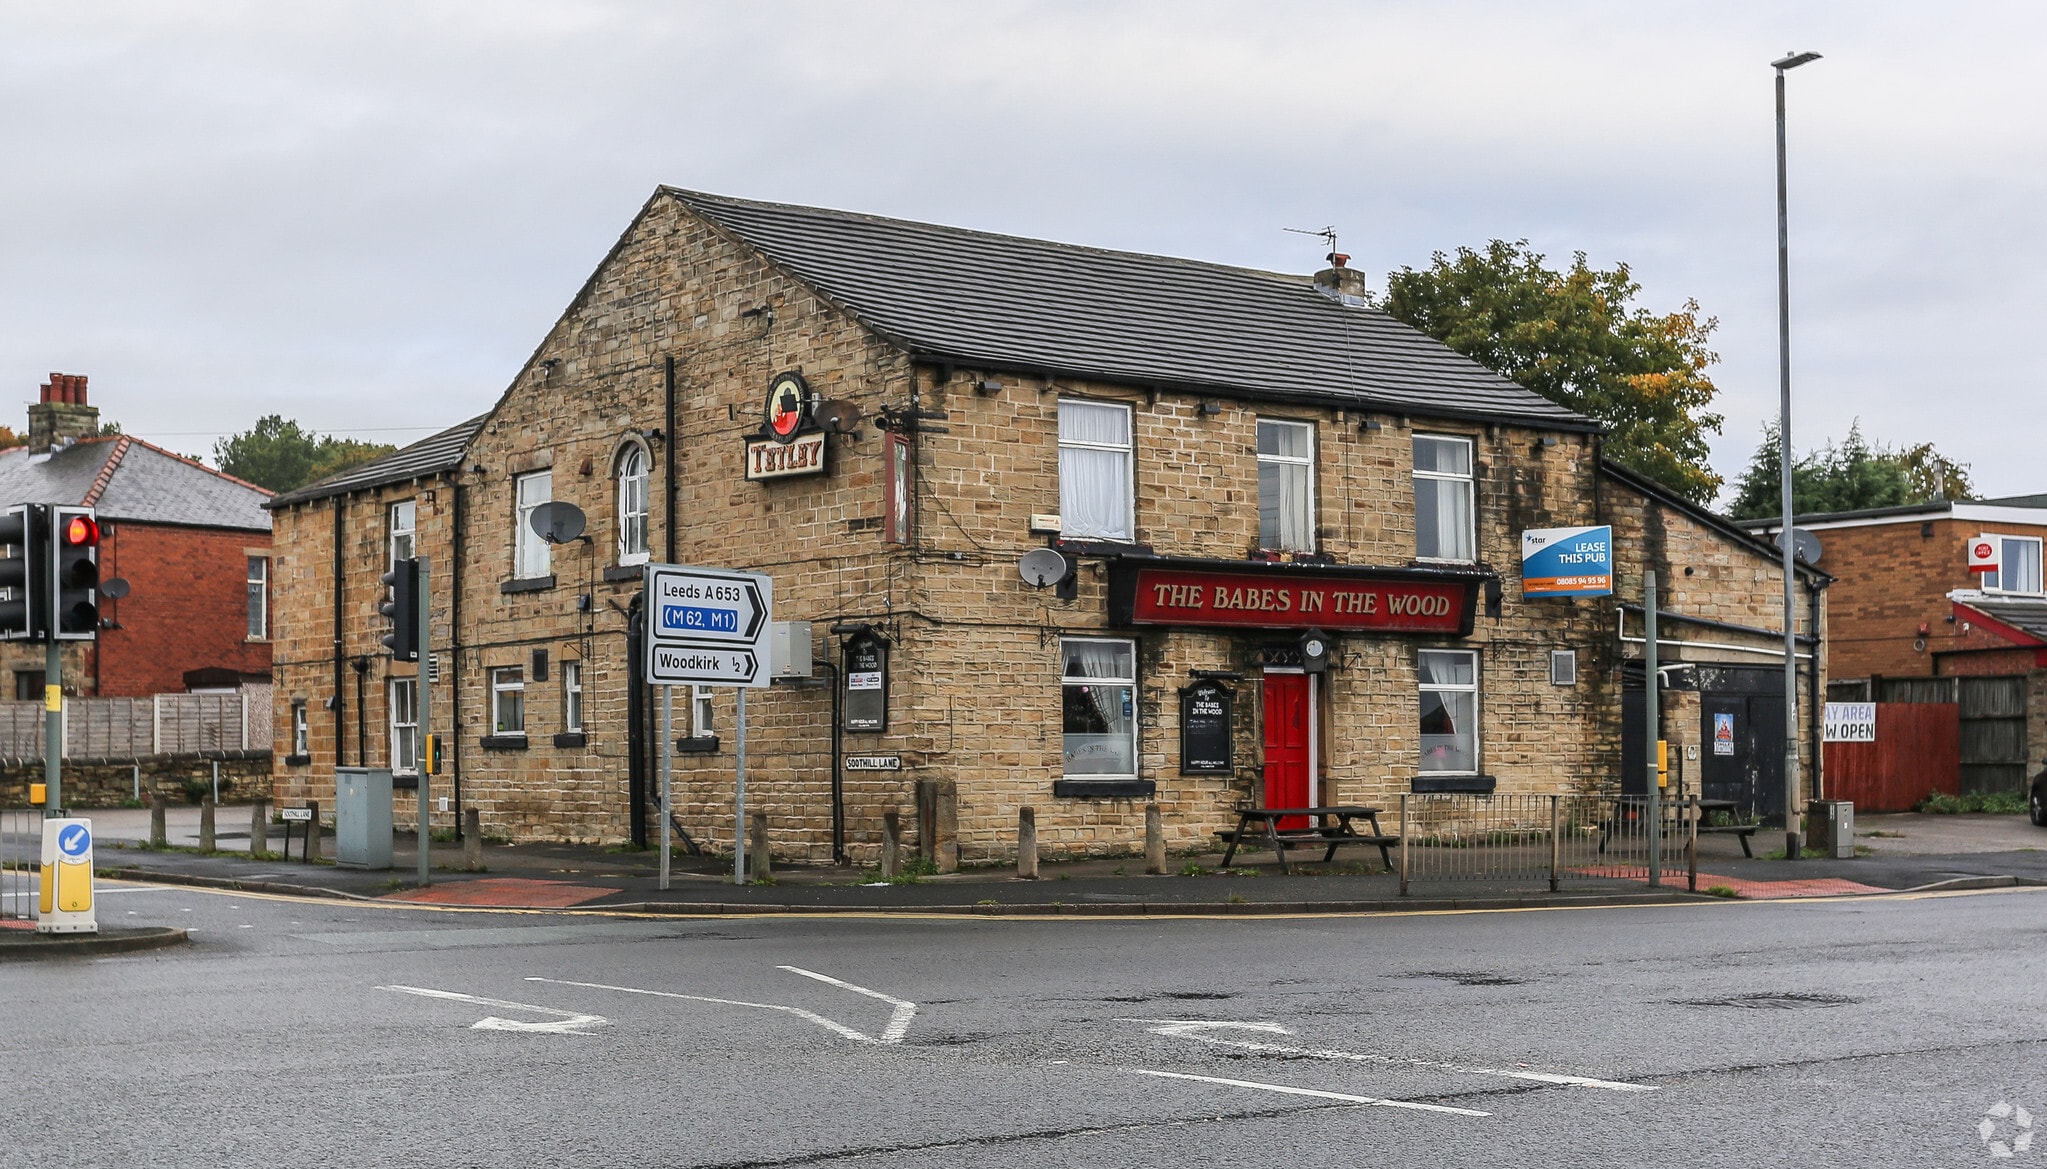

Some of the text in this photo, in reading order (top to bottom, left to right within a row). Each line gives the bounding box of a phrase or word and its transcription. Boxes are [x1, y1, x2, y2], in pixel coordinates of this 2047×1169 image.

[751, 441, 822, 473] TETLEY
[1531, 536, 1546, 545] star
[1575, 542, 1606, 553] LEASE
[1558, 552, 1606, 564] THIS PUB
[1556, 577, 1577, 586] 08085
[1577, 577, 1586, 585] 94
[1588, 576, 1597, 585] 95
[1597, 576, 1606, 584] 96
[663, 582, 740, 602] Leeds A653
[1153, 583, 1450, 617] THE BABES IN THE WOOD
[665, 607, 736, 630] (M62, M1)
[659, 653, 719, 670] Woodkirk
[1843, 706, 1872, 720] AREA
[1841, 723, 1873, 739] OPEN
[847, 758, 898, 768] SOOTHILL LANE
